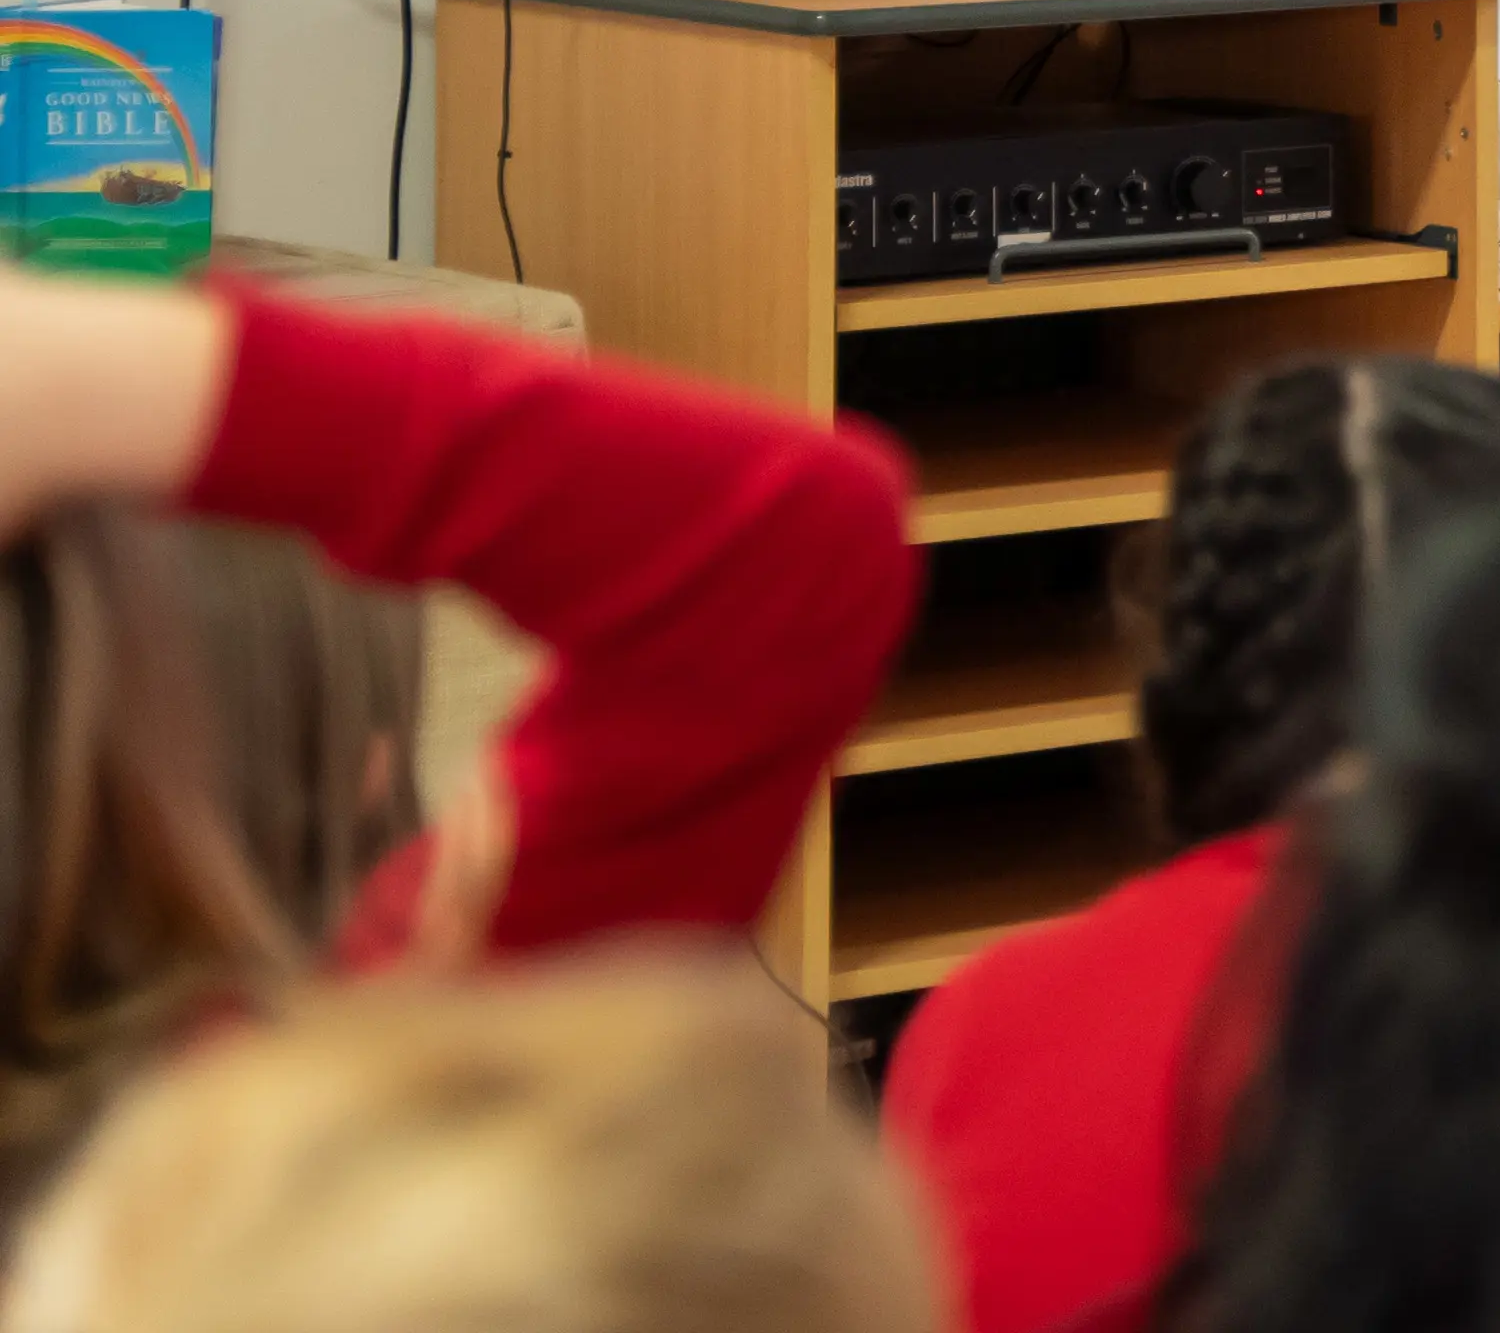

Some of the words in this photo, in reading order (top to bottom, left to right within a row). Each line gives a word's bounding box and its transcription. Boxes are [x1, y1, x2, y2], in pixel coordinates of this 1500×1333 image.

[46, 92, 107, 106] GOOD
[116, 92, 172, 106] NEWS
[47, 110, 171, 135] BIBLE
